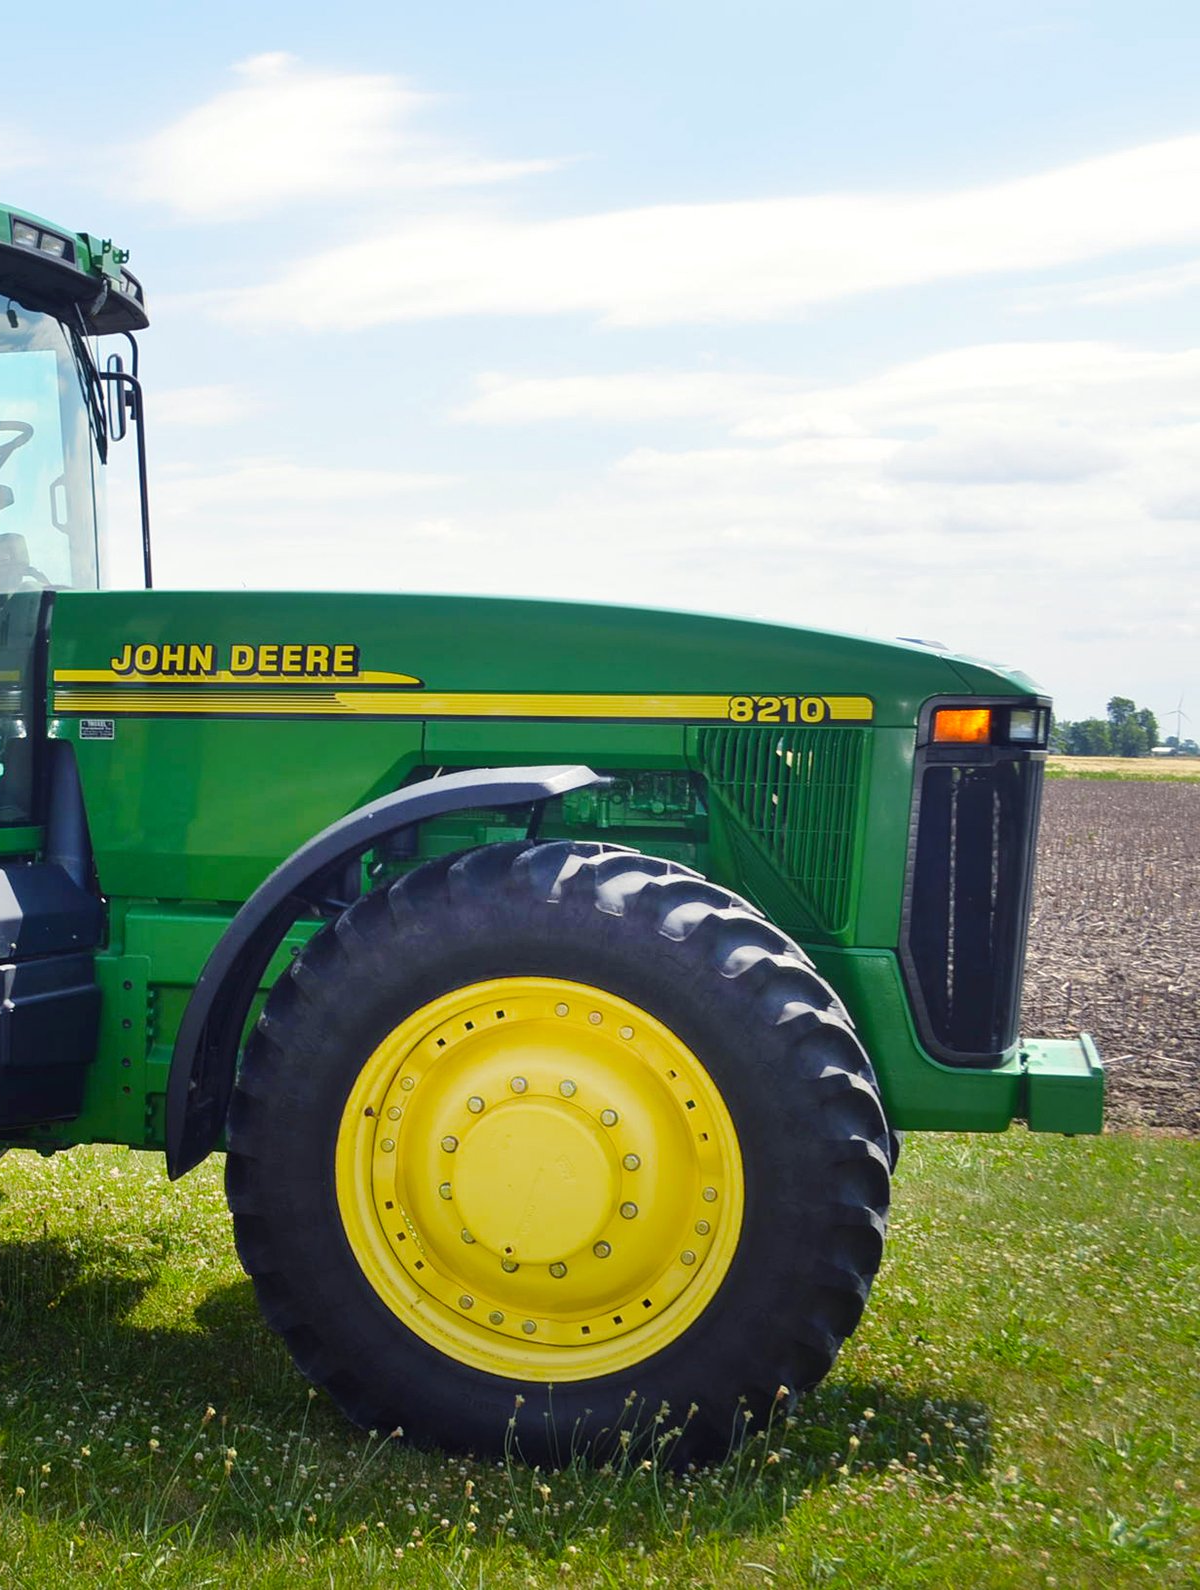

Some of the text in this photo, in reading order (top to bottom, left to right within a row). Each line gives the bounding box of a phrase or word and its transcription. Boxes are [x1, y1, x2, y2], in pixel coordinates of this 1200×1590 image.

[111, 644, 356, 674] JOHN DEERE
[729, 696, 826, 723] 8210
